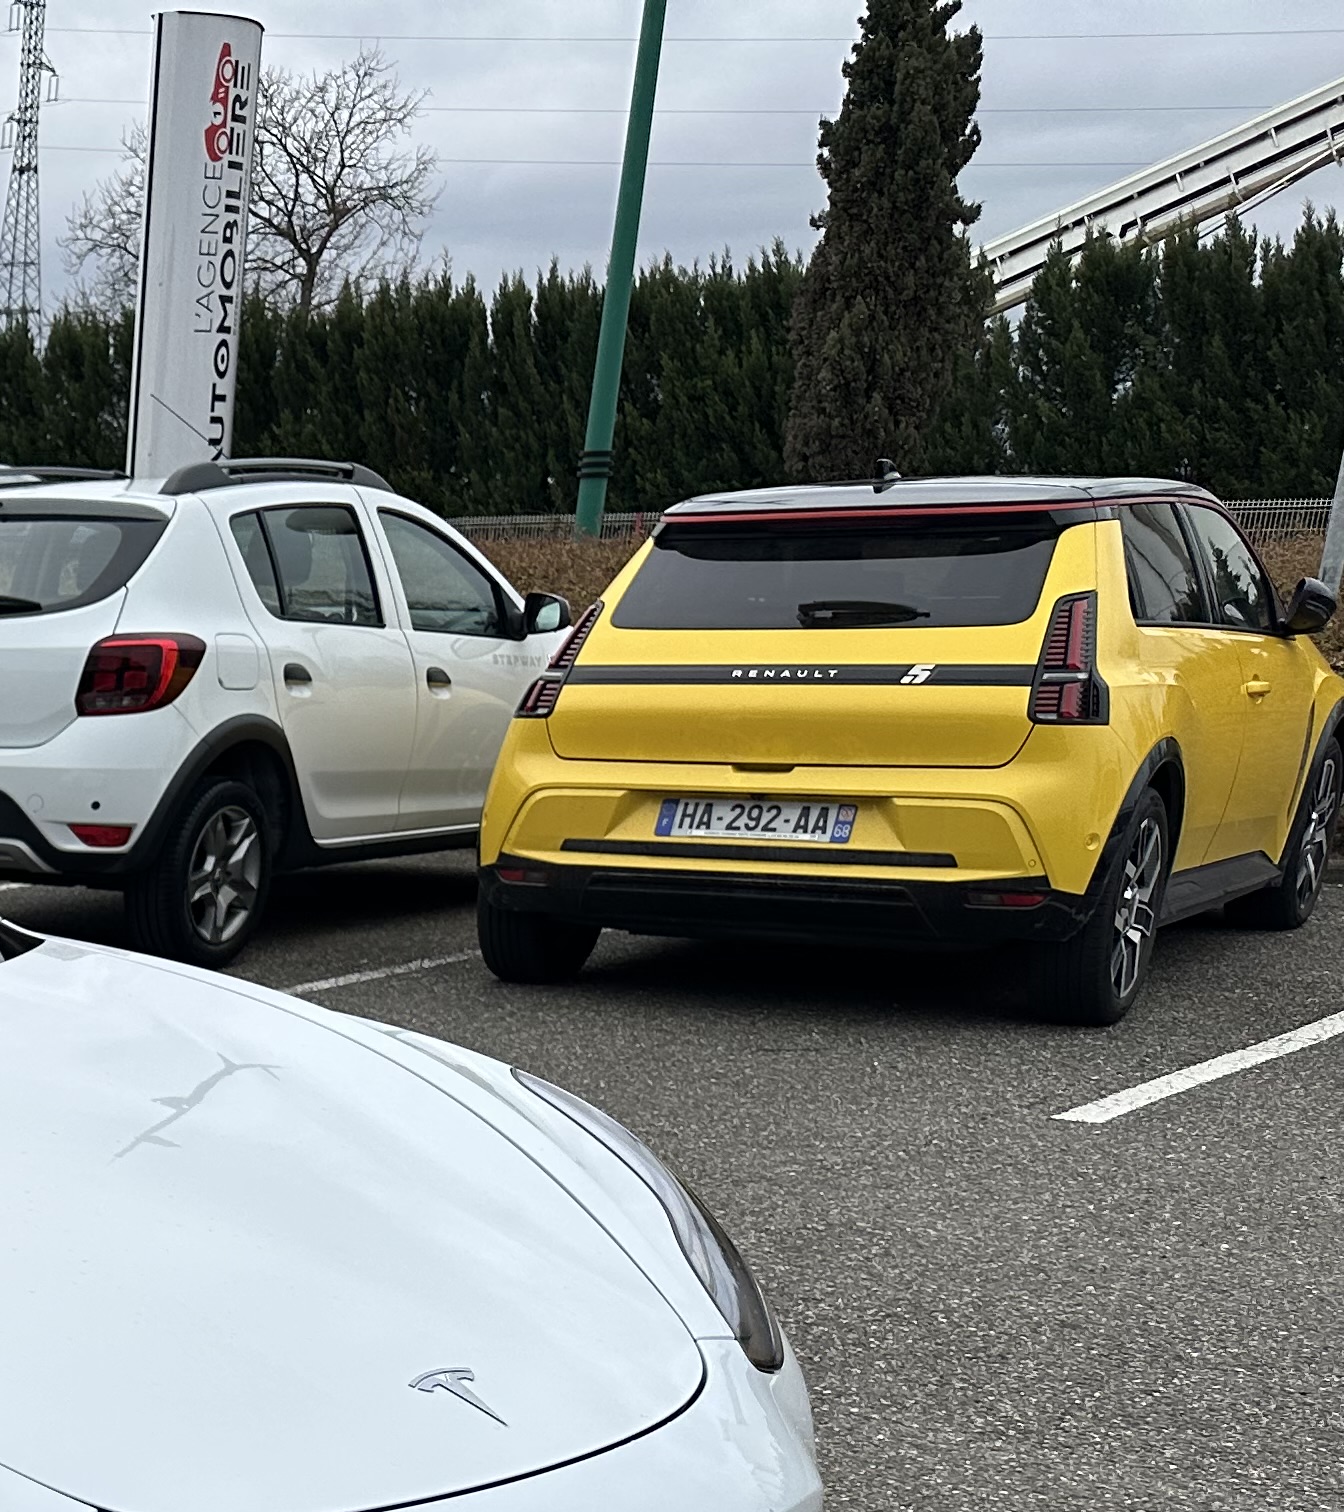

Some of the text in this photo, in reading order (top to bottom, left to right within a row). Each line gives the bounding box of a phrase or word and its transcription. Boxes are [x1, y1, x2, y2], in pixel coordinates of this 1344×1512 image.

[193, 163, 224, 334] L'AGENCE
[731, 669, 838, 678] RENAULT
[677, 801, 830, 835] HA-292-AA
[833, 823, 850, 838] 68
